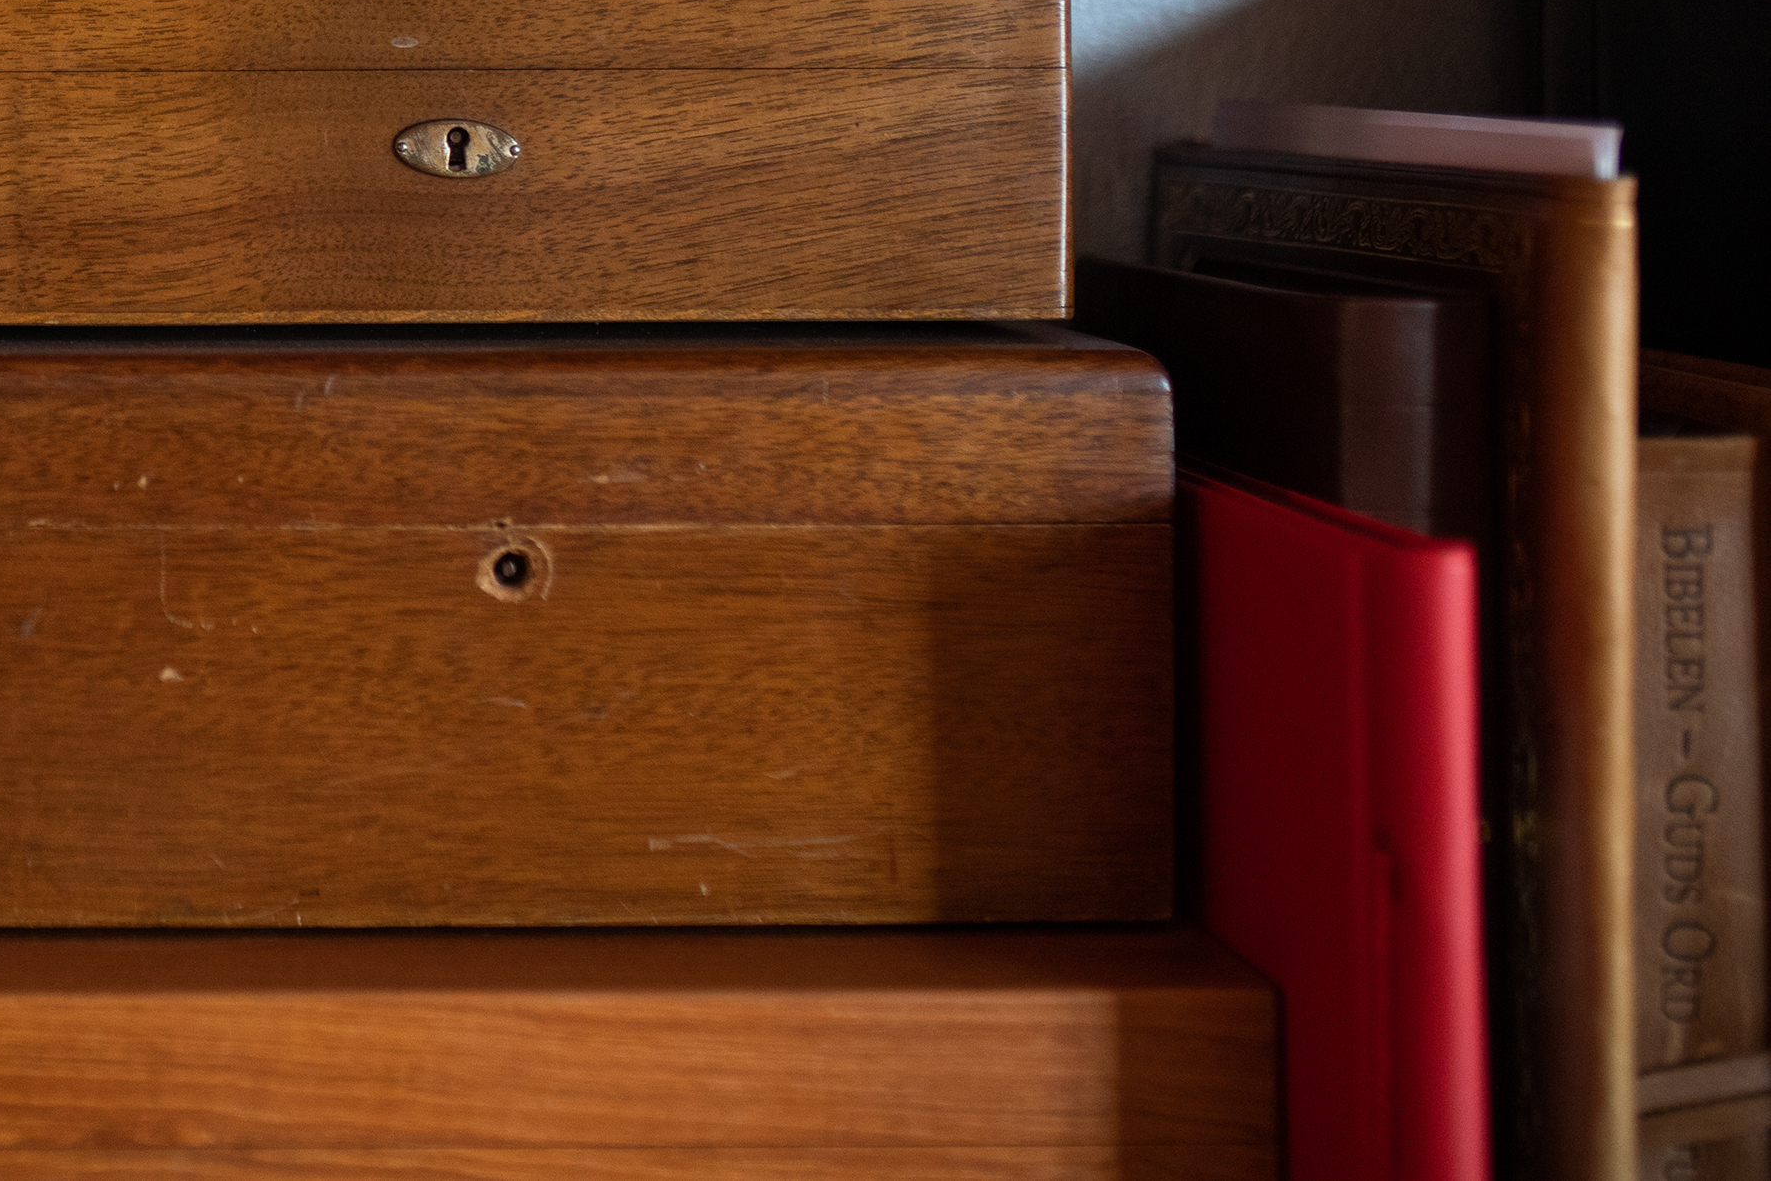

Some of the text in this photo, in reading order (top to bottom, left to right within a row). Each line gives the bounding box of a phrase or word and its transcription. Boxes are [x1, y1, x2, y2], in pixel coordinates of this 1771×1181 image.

[1660, 523, 1713, 714] BIBELEN
[1663, 773, 1720, 905] GUDS
[1660, 920, 1718, 1023] ORD
